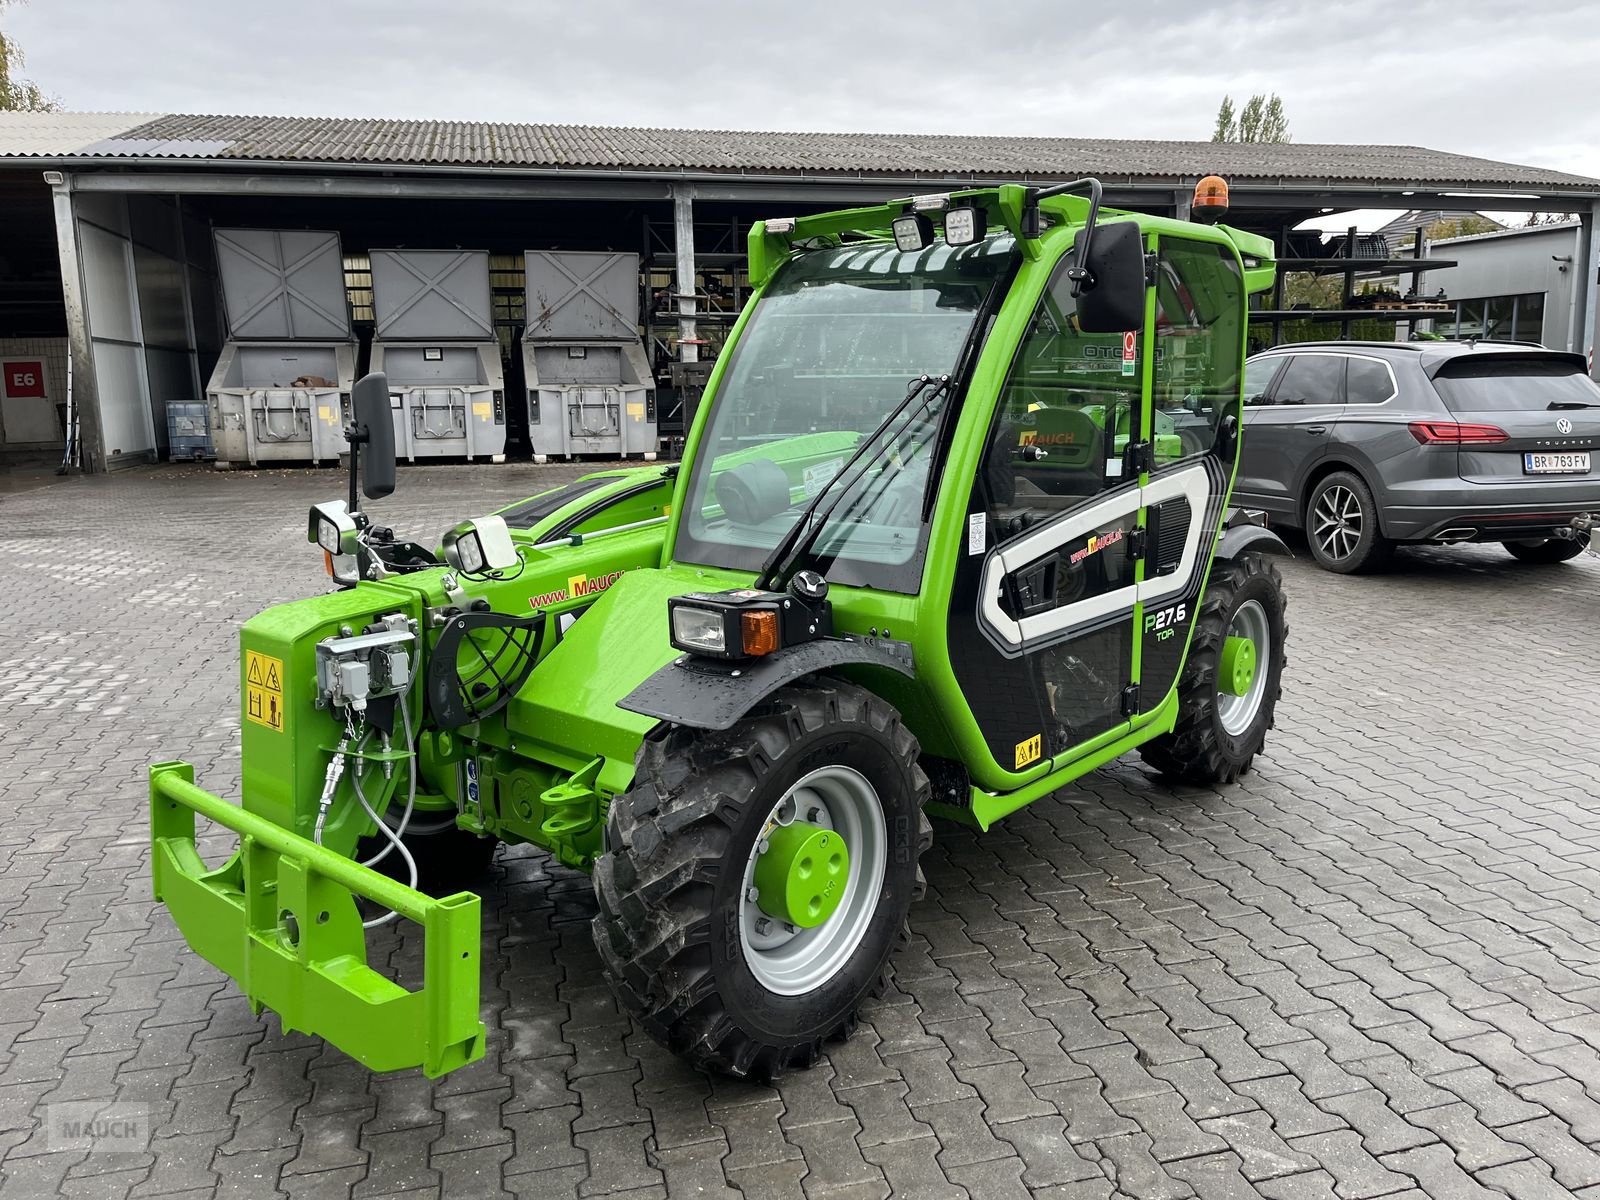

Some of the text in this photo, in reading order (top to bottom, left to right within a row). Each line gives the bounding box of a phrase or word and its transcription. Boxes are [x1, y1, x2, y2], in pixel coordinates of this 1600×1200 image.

[13, 373, 35, 387] E6
[1023, 432, 1075, 447] MAUCH
[1534, 455, 1586, 468] BR 763 FV
[529, 571, 625, 609] www.MAUC
